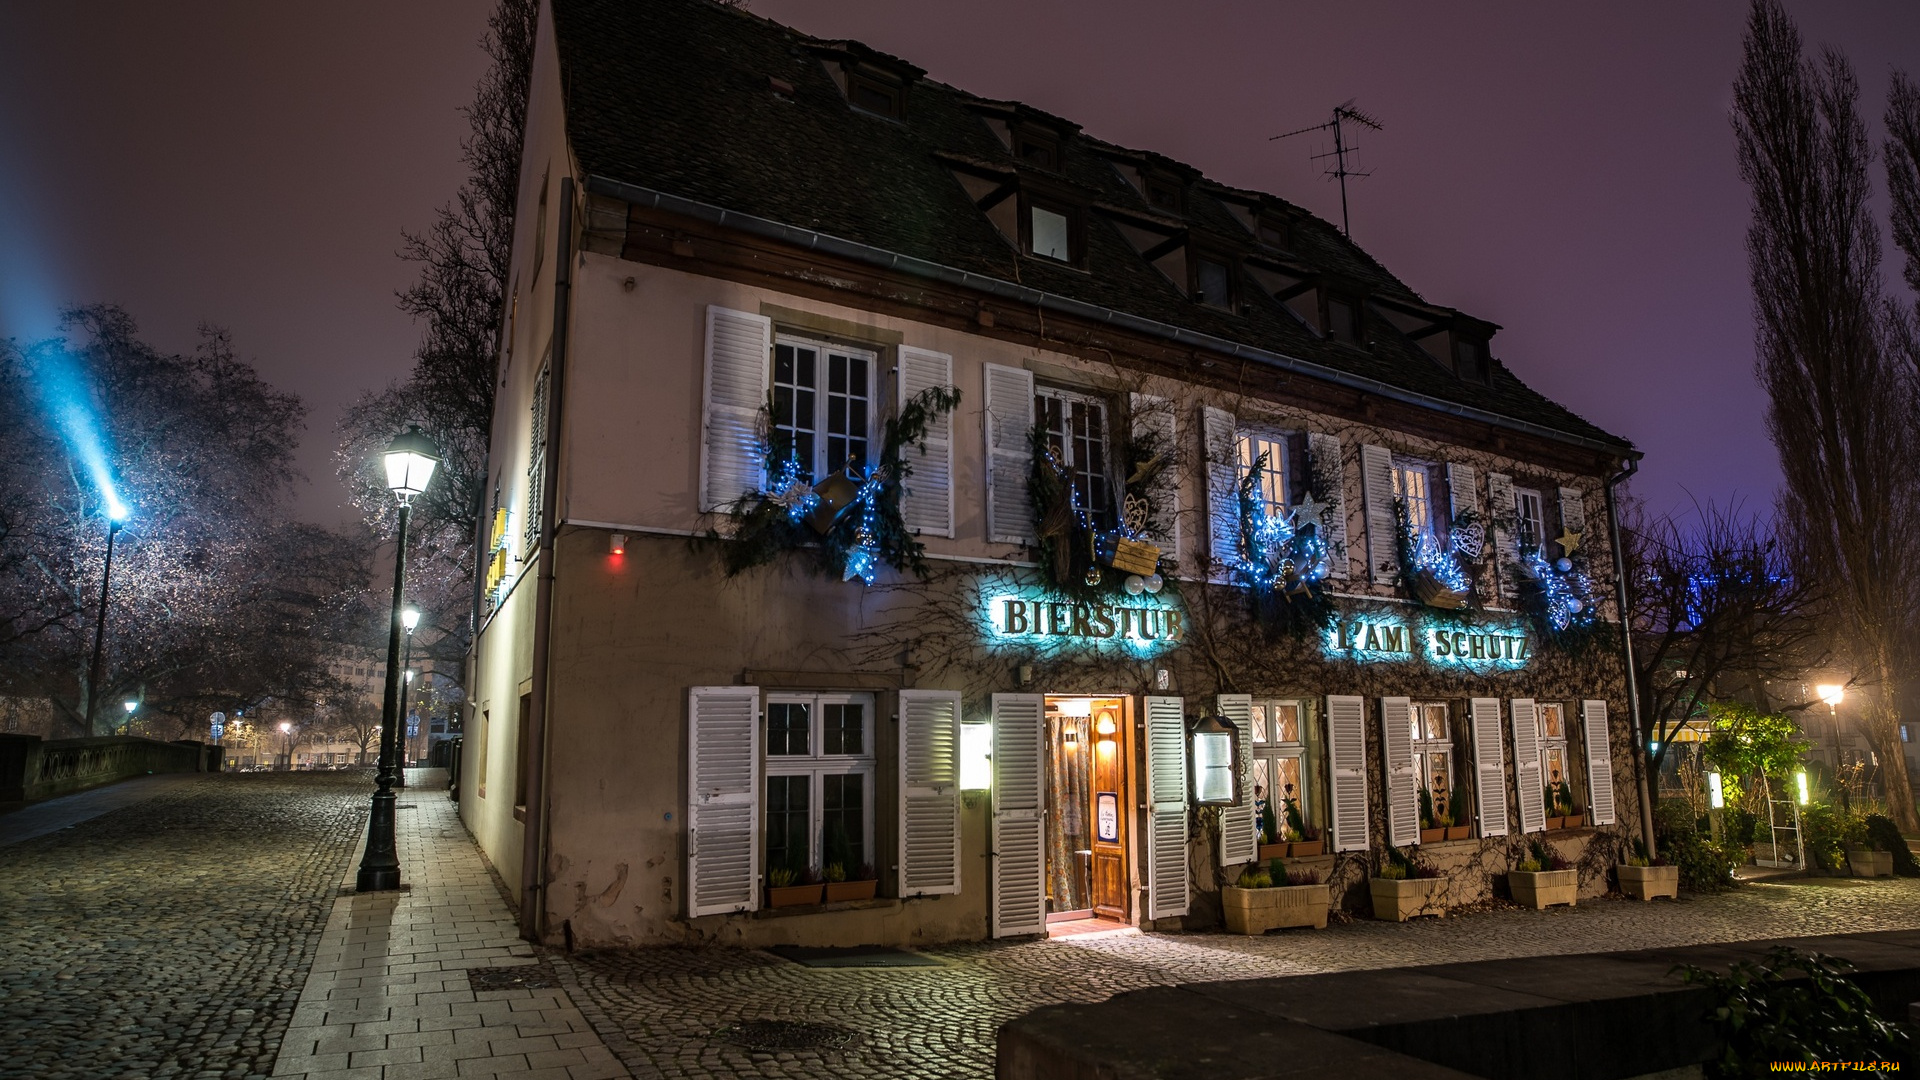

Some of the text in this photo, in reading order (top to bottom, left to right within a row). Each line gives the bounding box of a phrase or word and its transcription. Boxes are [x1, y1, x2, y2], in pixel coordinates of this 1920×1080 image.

[1002, 599, 1183, 641] BIERSTUB
[1337, 621, 1531, 660] L'AMI SCHUTZ
